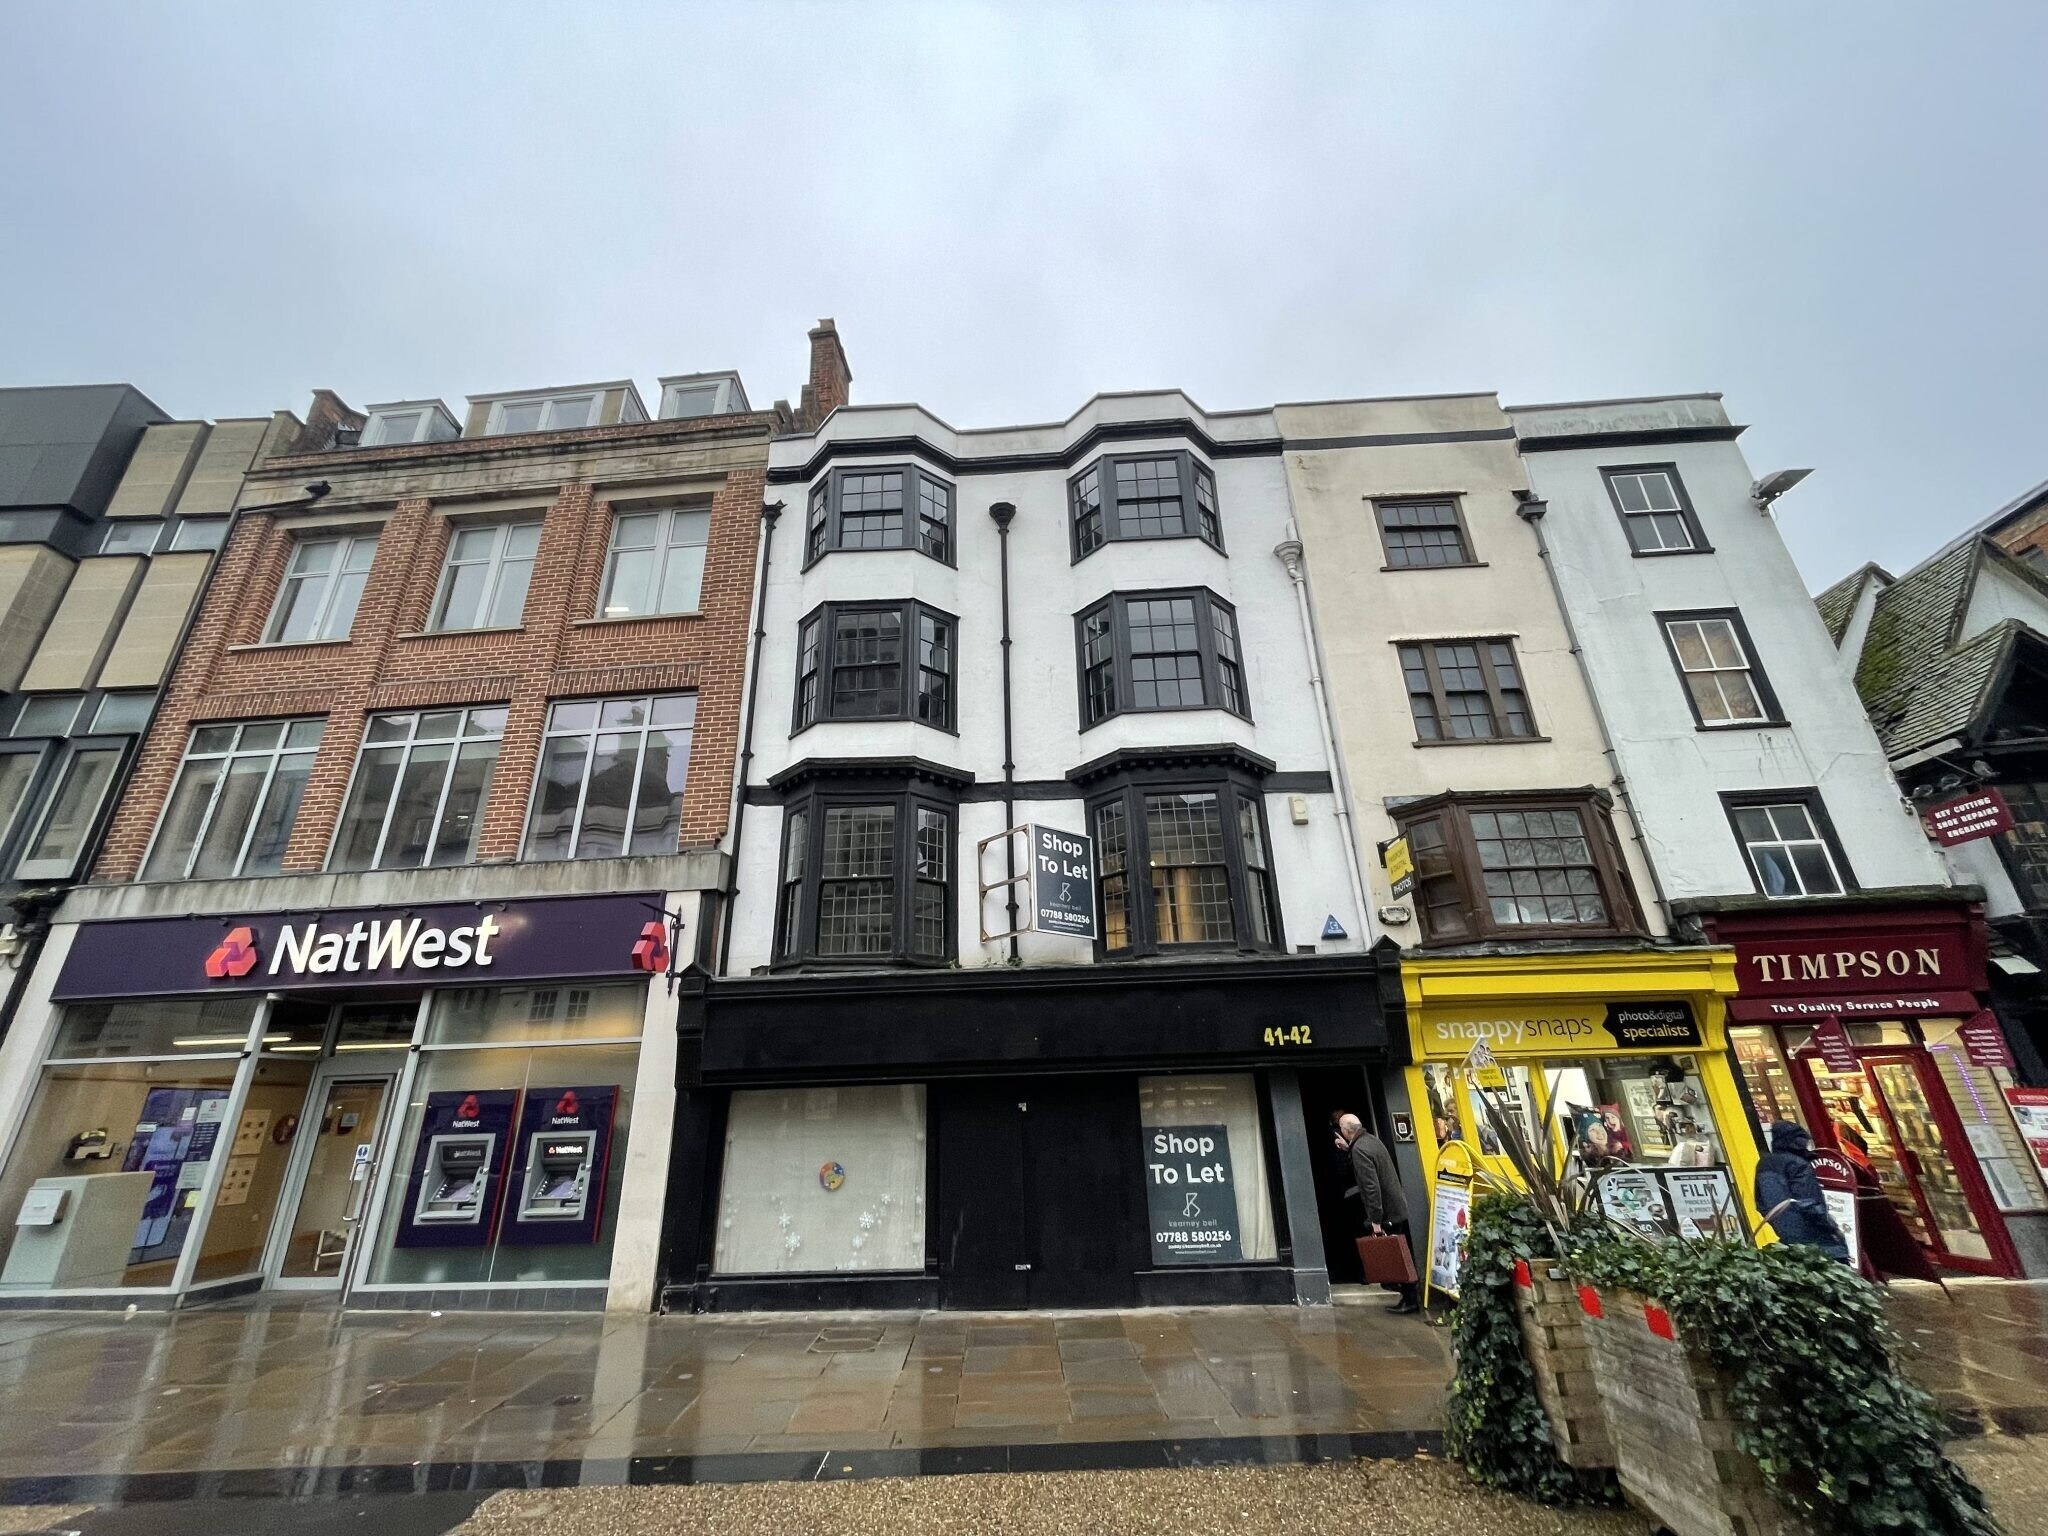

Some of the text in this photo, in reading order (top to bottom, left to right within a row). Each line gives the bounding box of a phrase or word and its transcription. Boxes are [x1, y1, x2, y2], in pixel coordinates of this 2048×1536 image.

[1935, 797, 1991, 819] KEY CUTTING
[1937, 806, 1999, 830] SHOE REPAIRS
[1947, 818, 1998, 838] ENGRAVING
[1042, 833, 1083, 858] Shop
[1038, 854, 1088, 880] To Let
[1393, 876, 1412, 895] PHOTOS
[1041, 908, 1063, 919] 07788
[1064, 912, 1090, 924] 580256
[268, 914, 500, 975] NatWest
[1753, 948, 1942, 982] TIMPSON
[1771, 998, 1940, 1013] The Quality Service People
[1618, 1009, 1685, 1023] photo&digital
[1264, 1025, 1313, 1046] 41-42
[1623, 1026, 1690, 1041] specialists
[552, 1116, 579, 1124] NatWest
[556, 1145, 583, 1154] NatWest
[1154, 1133, 1214, 1156] Shop
[1149, 1163, 1225, 1184] To Let
[1811, 1158, 1850, 1177] IMPSON
[1680, 1183, 1718, 1197] FILM
[1168, 1220, 1200, 1228] kearney
[1156, 1230, 1232, 1243] 07788 580256
